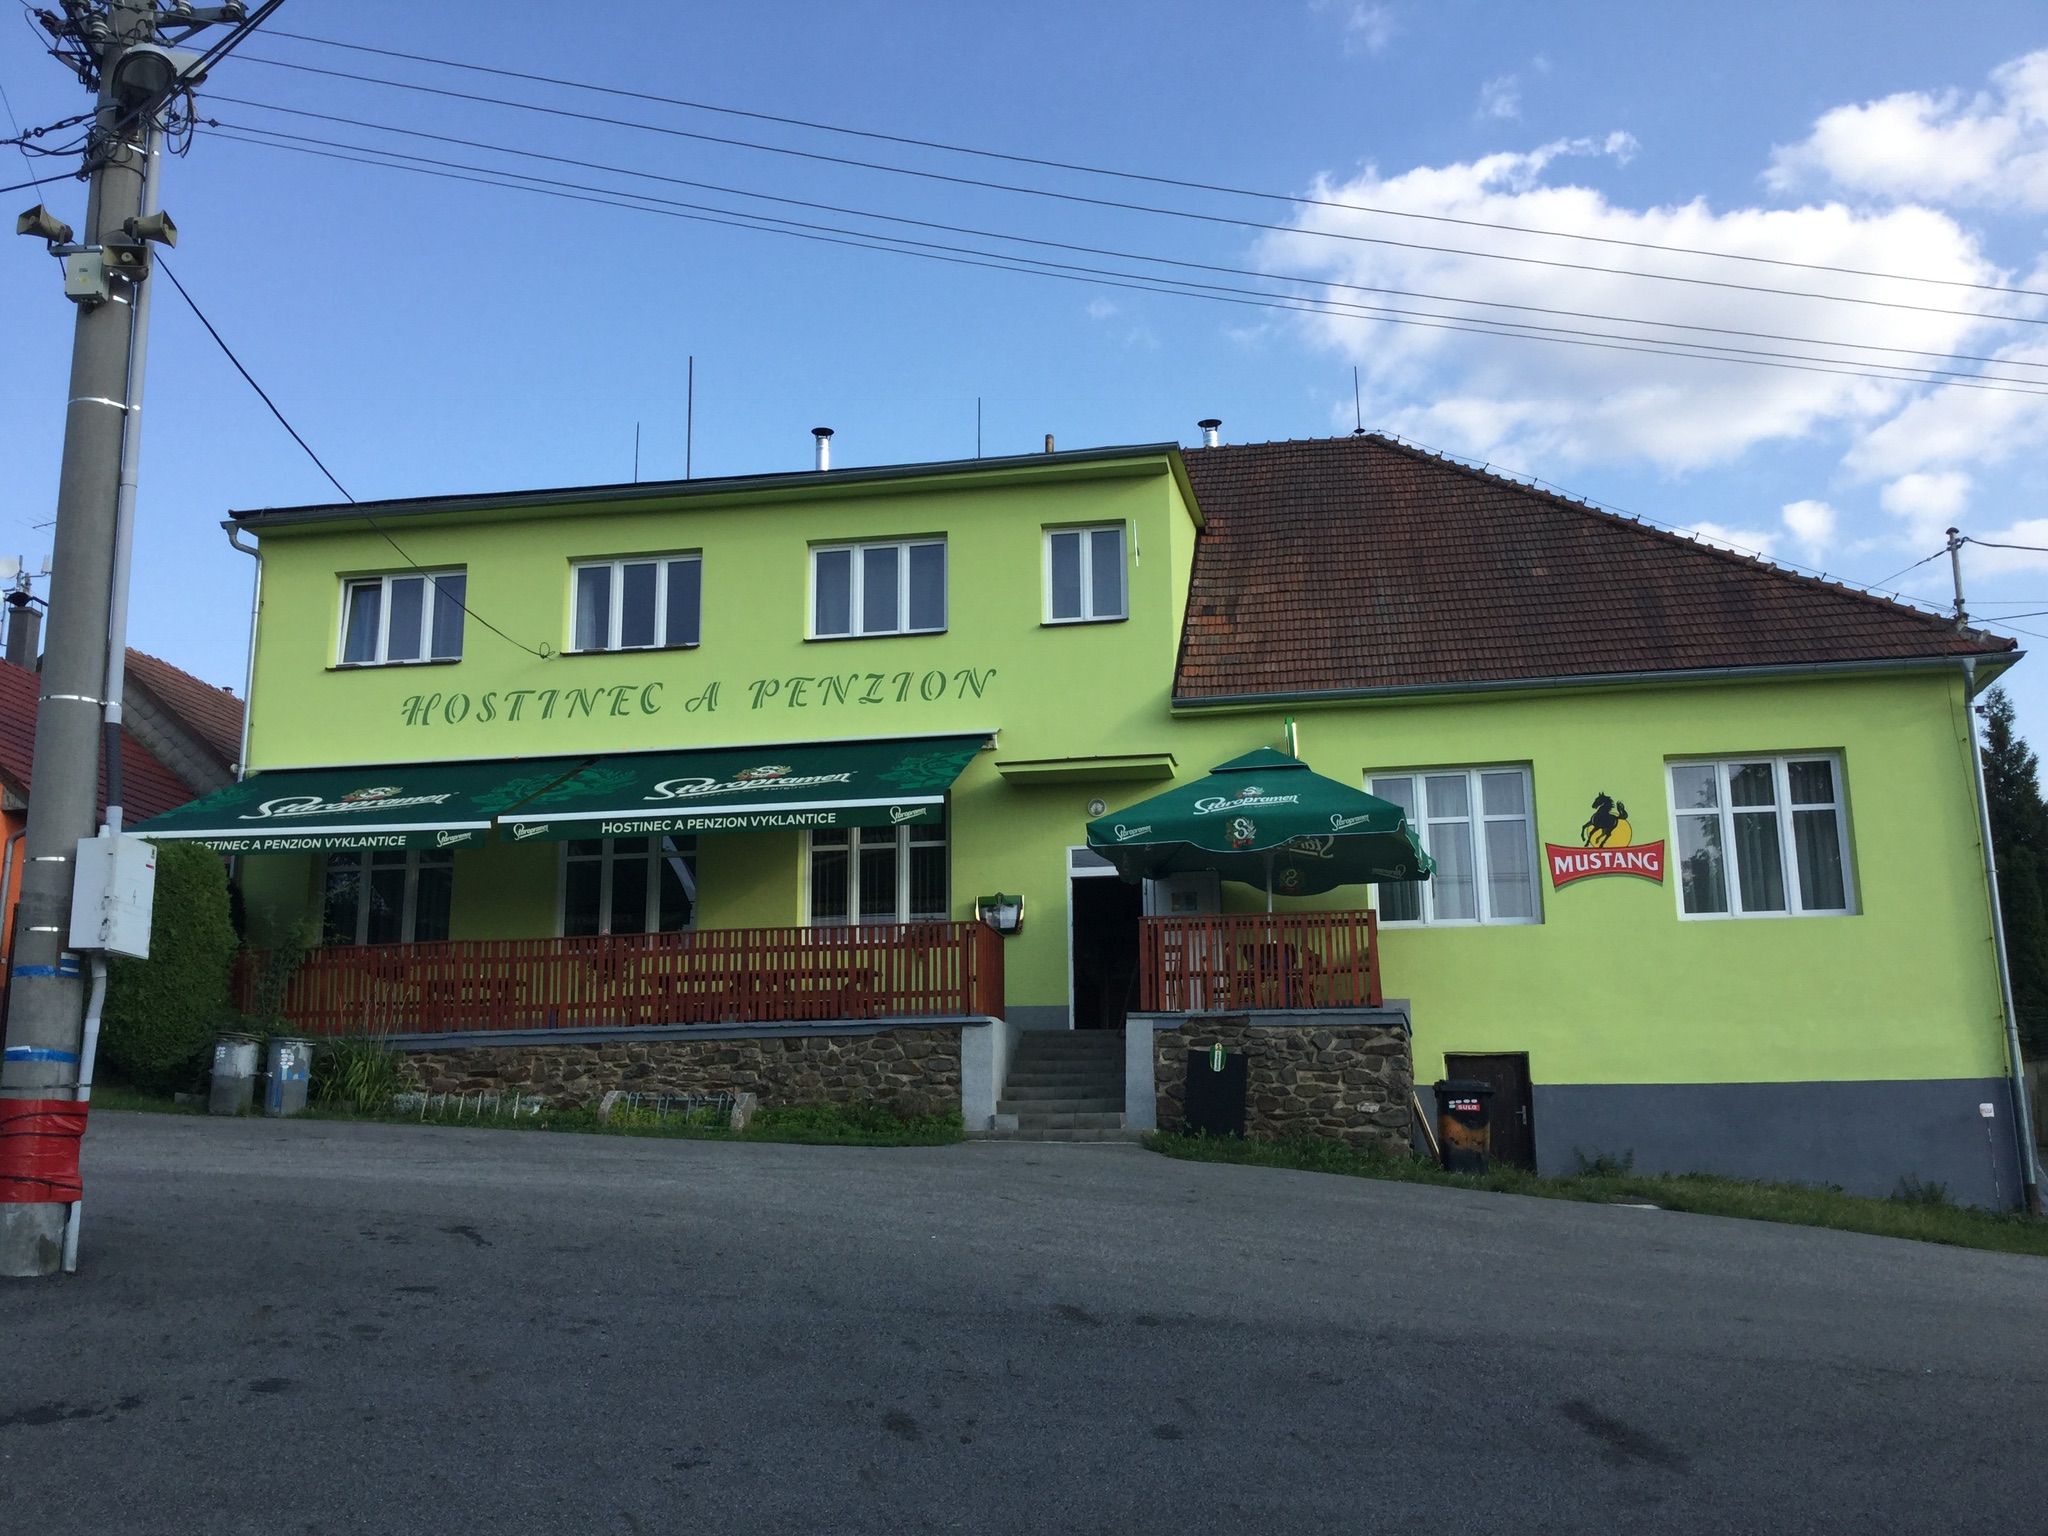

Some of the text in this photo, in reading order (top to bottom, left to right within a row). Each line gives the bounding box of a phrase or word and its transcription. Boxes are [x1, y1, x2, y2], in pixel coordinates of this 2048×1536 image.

[401, 667, 997, 726] HOSTINEC A PENZION
[643, 773, 852, 801] Staropramen
[1193, 793, 1300, 816] Staropramen
[601, 812, 836, 834] HOSTINEC A PENZION VYKLANTICE
[252, 839, 261, 850] A
[264, 838, 322, 849] PENZION
[325, 835, 407, 848] VYKLANTICE
[1554, 851, 1659, 875] MUSTANG
